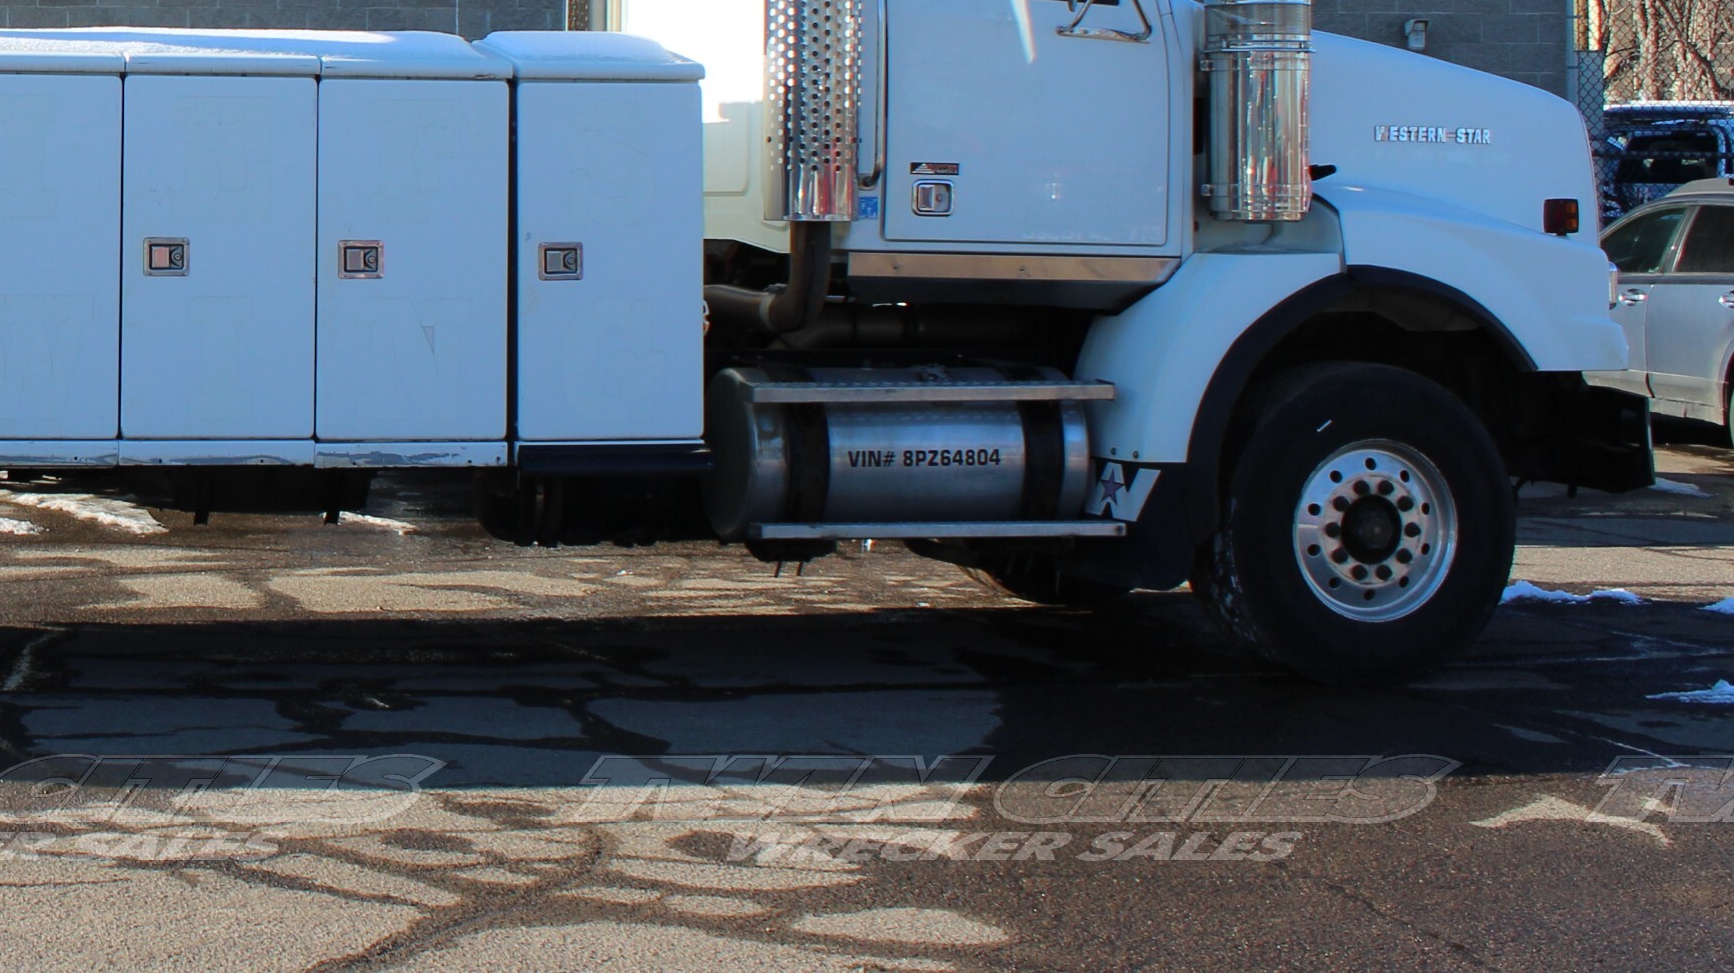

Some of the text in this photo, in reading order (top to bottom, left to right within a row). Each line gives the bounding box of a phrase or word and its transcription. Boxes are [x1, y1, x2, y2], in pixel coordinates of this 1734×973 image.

[1374, 125, 1492, 145] WESTERN STAR
[848, 448, 1001, 468] VIN# 8PZ64804
